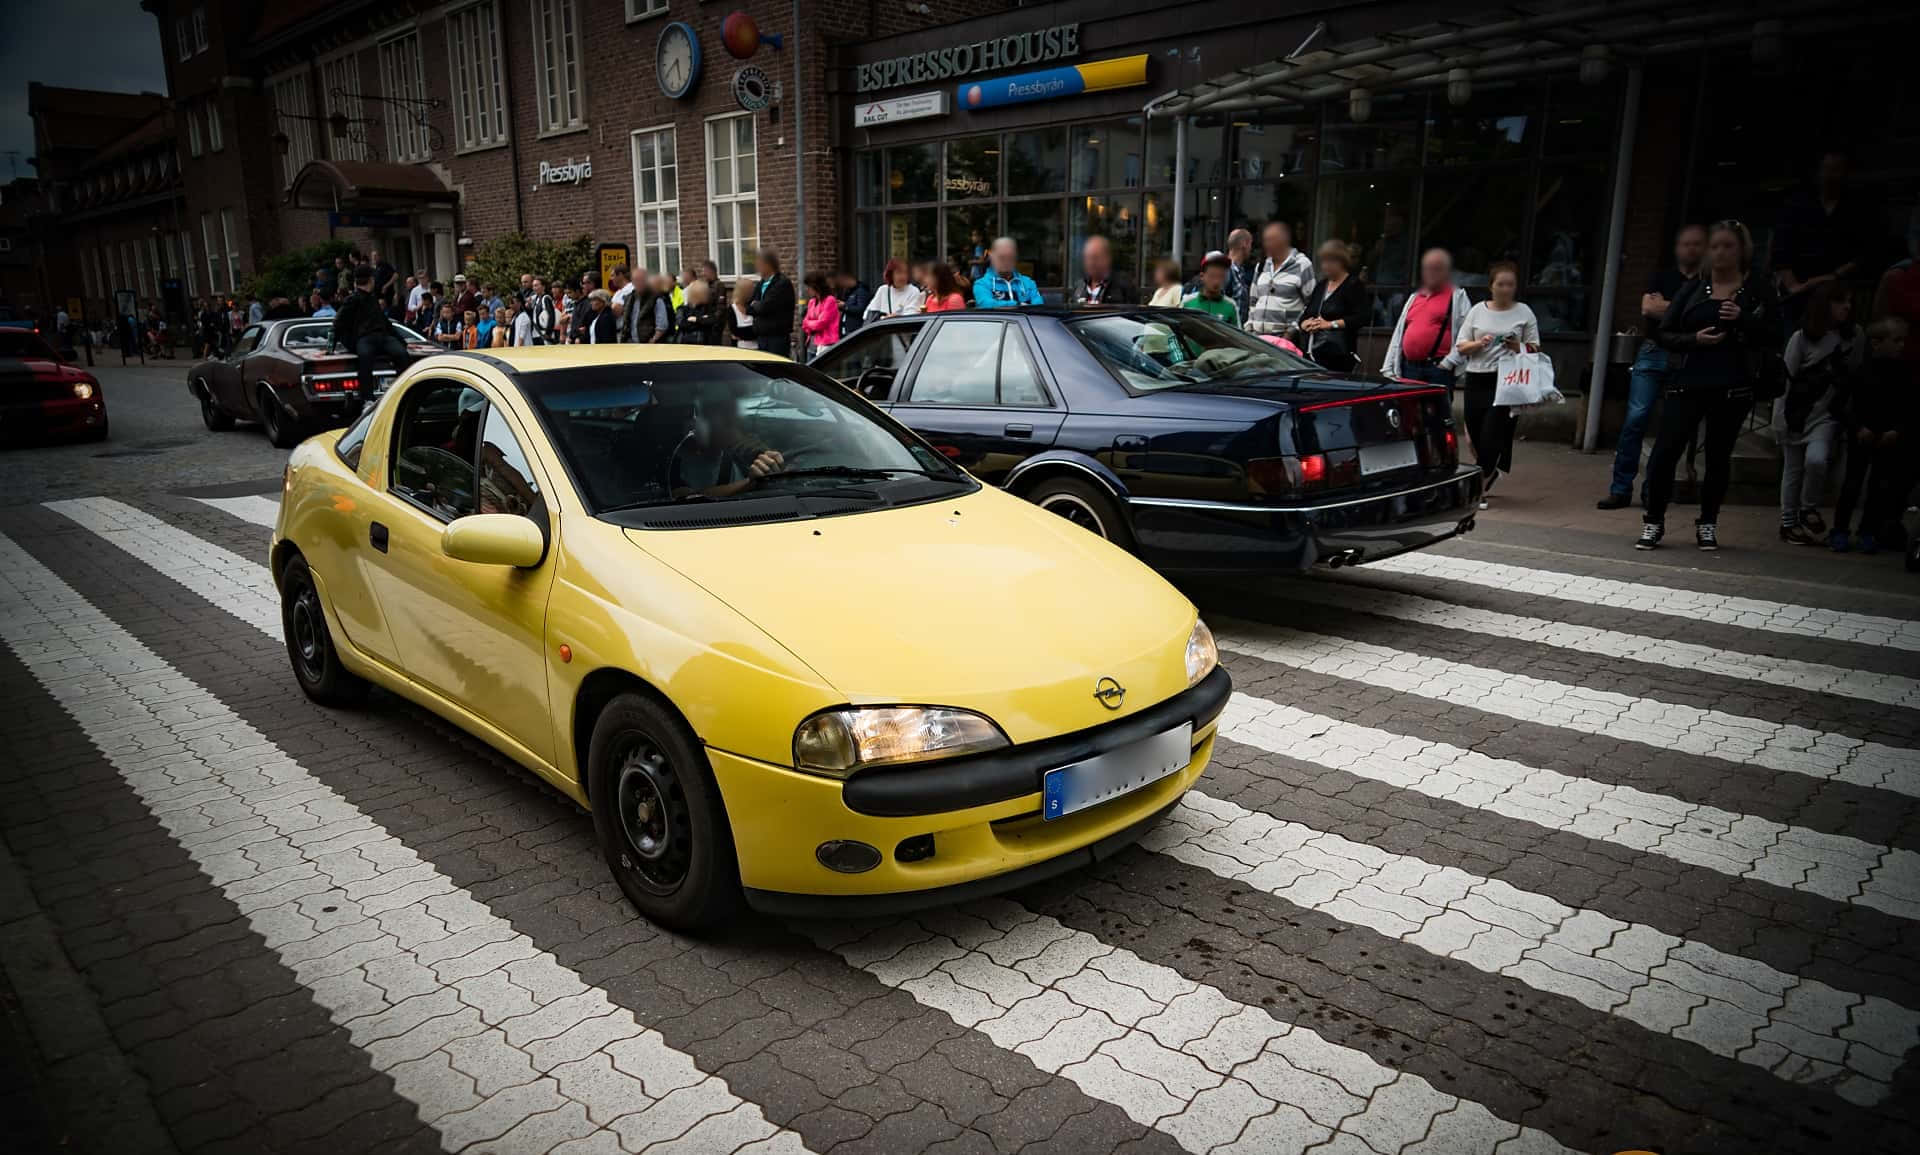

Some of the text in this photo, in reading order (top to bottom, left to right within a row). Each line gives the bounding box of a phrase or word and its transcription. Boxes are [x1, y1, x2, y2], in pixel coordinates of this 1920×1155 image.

[857, 23, 1079, 92] ESPRESSO HOUSE
[1008, 77, 1064, 98] Pressbyrån
[539, 156, 592, 185] Pressbyrå
[1051, 799, 1058, 809] S
